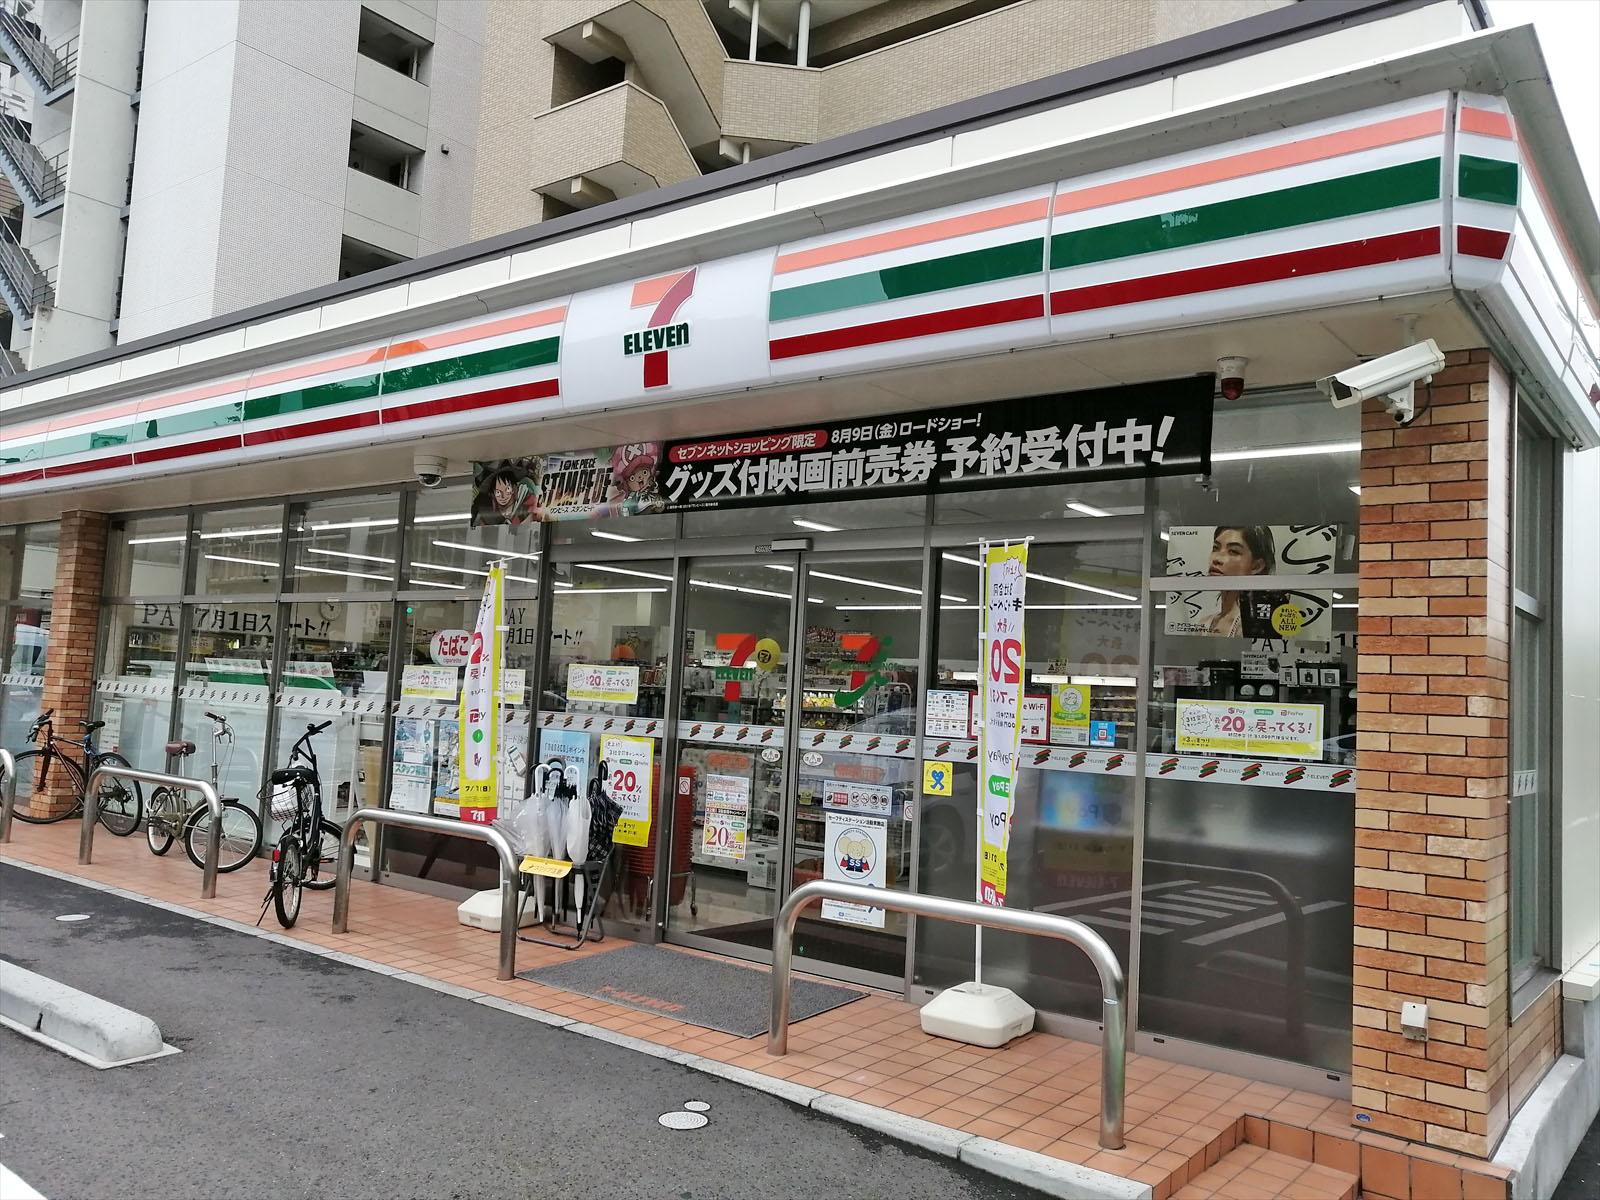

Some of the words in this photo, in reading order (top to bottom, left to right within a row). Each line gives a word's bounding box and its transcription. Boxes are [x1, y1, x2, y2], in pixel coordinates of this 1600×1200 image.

[630, 267, 698, 388] 7
[899, 412, 983, 435] ロードショー!
[677, 432, 817, 459] セブンネットショッピング限定
[665, 440, 938, 501] グッズ付映画前売券
[942, 415, 1176, 479] 予約受付中!
[142, 603, 181, 627] PA
[438, 636, 469, 657] たばこ
[589, 675, 602, 687] 20
[1028, 703, 1046, 711] Wi-Fi
[1221, 715, 1246, 733] 20
[1256, 718, 1313, 735] 戻ってくる!
[613, 769, 637, 793] 20
[705, 825, 729, 848] 20
